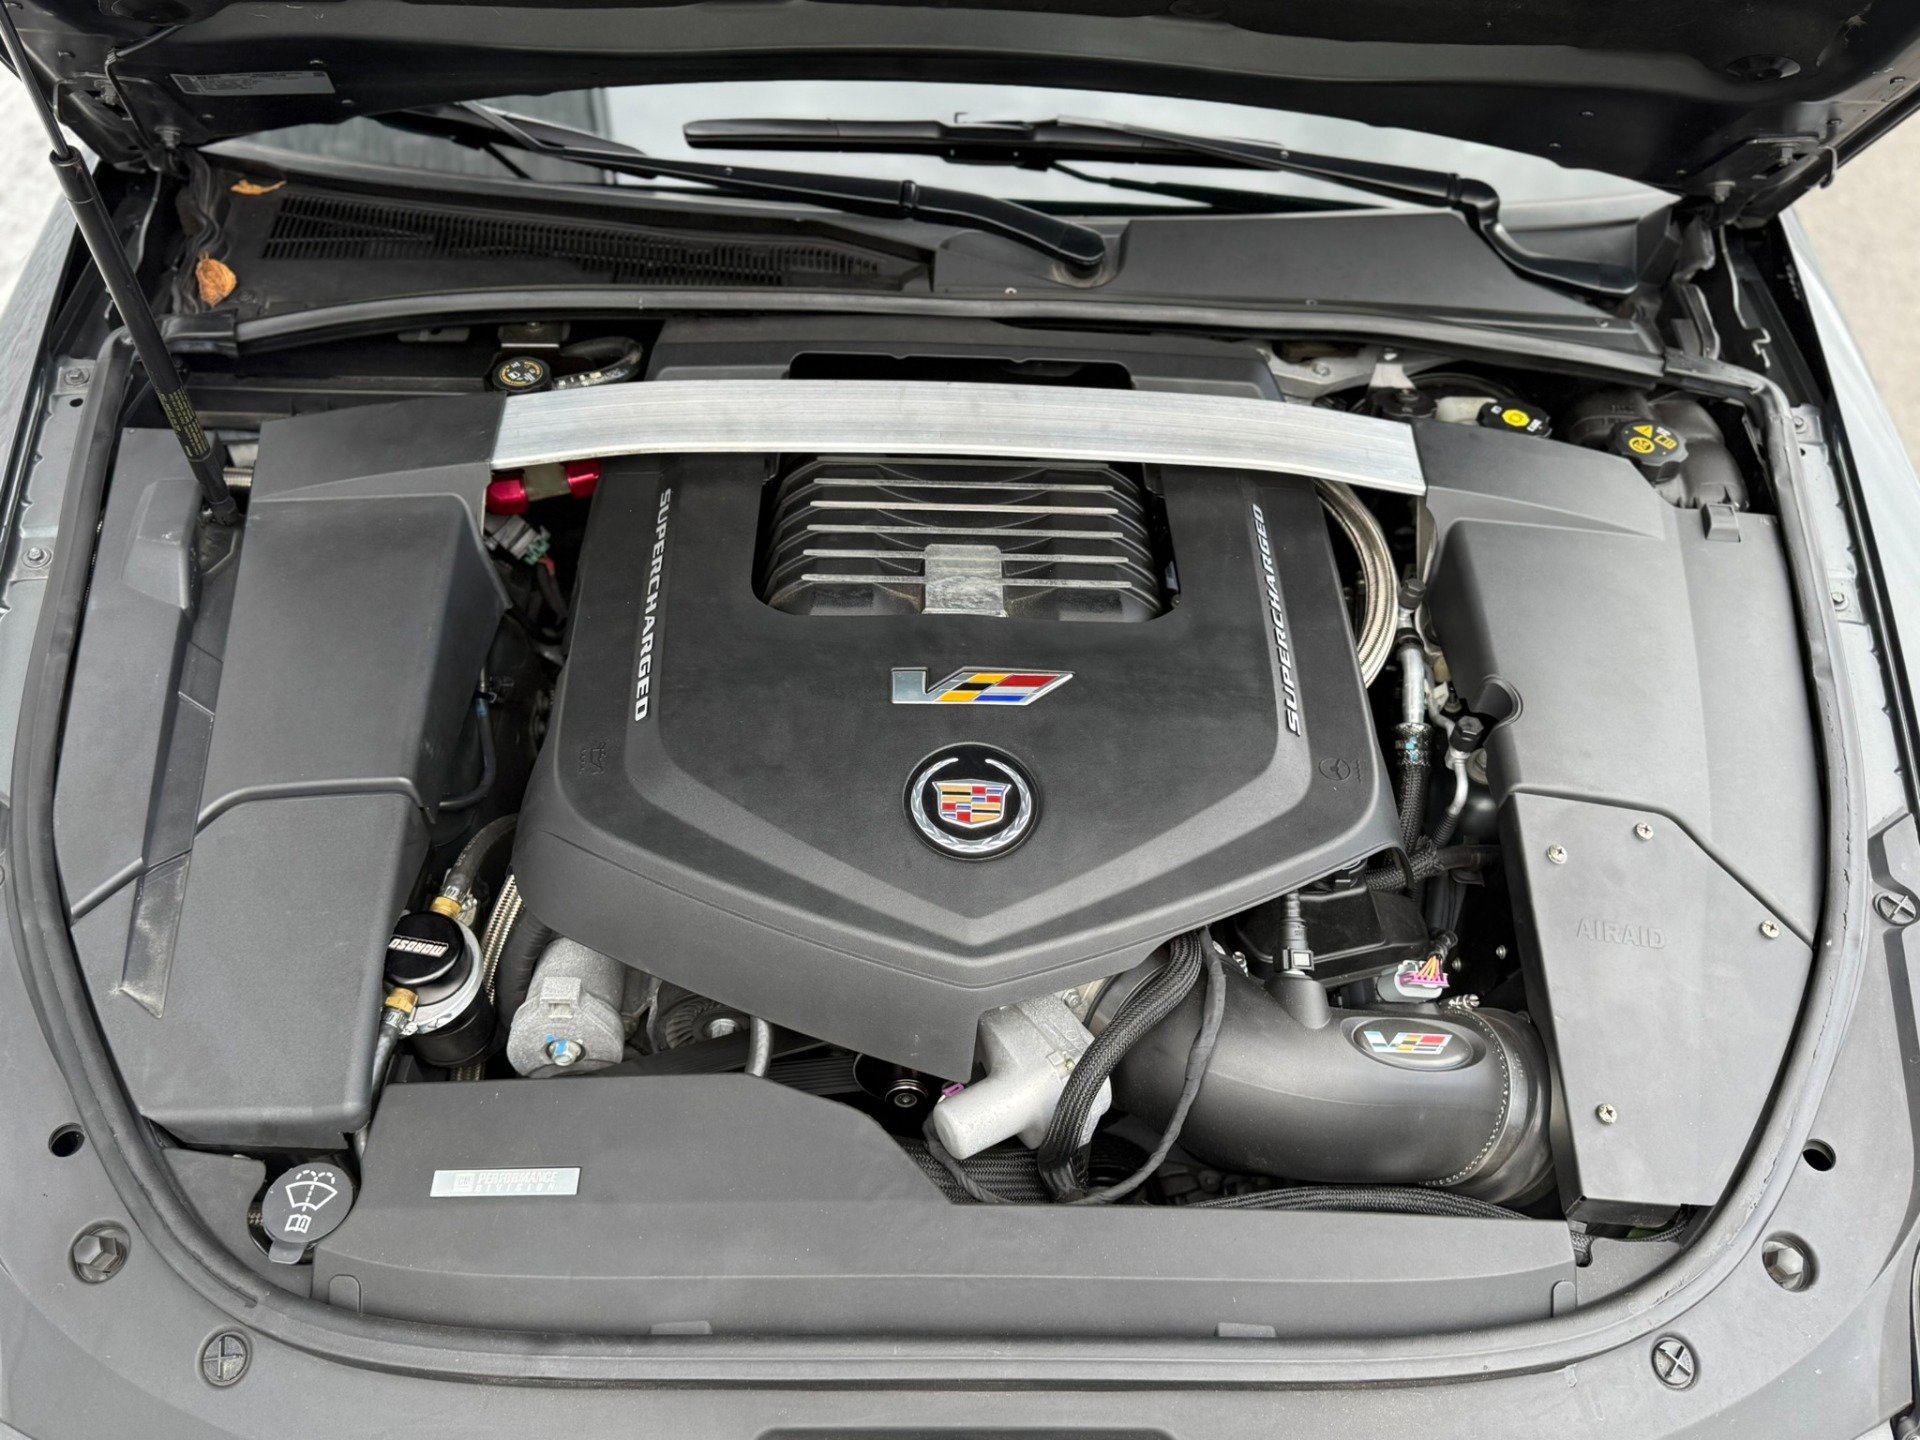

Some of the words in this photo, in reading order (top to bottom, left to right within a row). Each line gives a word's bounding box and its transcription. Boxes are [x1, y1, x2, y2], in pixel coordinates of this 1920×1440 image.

[634, 487, 672, 722] SUPERCHARGED
[1252, 503, 1301, 737] SUPERCHARGED
[1576, 918, 1666, 950] AIRAID
[388, 938, 448, 958] MOROSO
[474, 1183, 557, 1193] DIVISION
[477, 1171, 558, 1185] PERFORMANCE
